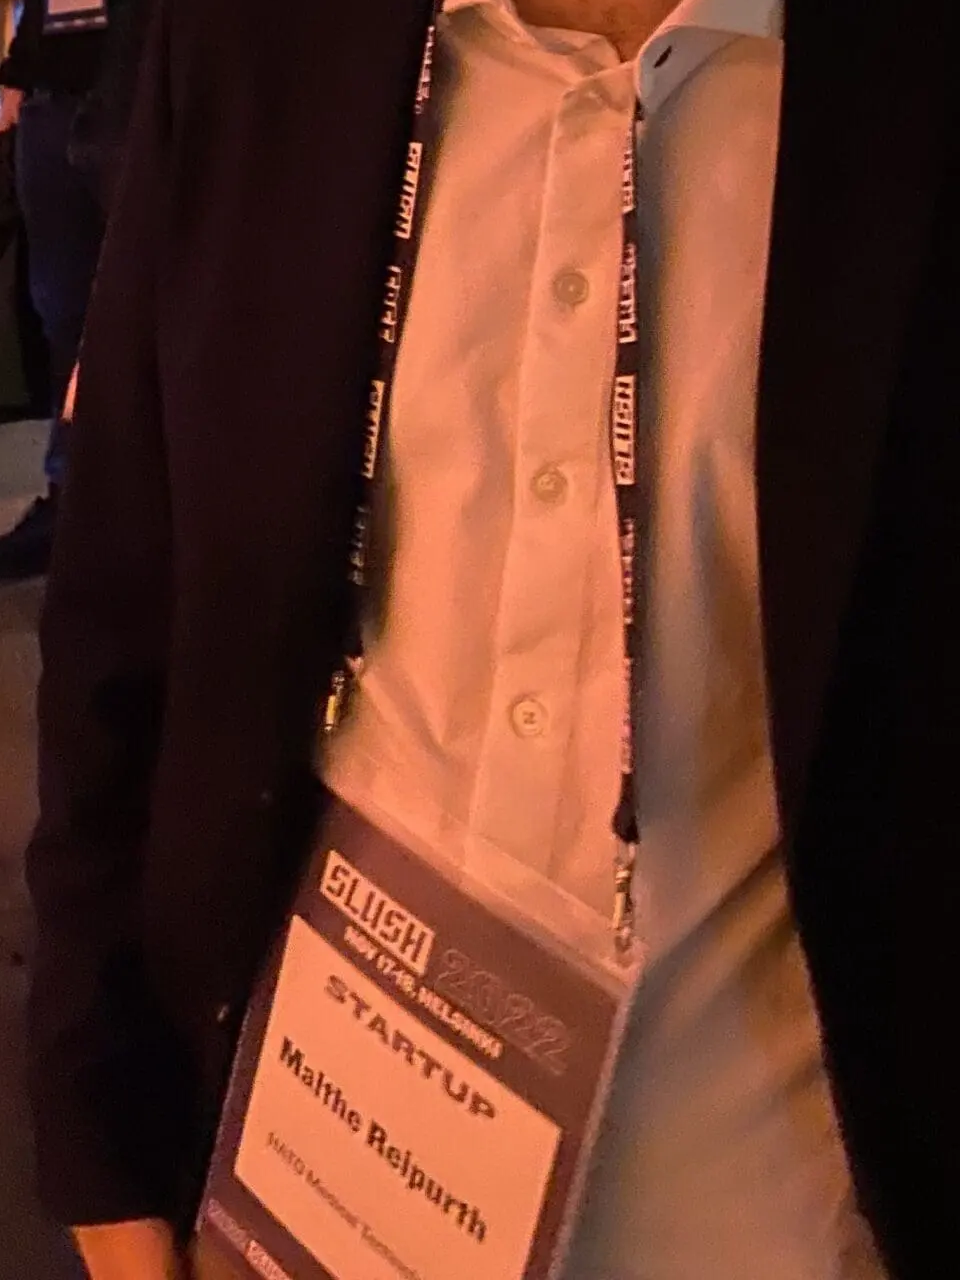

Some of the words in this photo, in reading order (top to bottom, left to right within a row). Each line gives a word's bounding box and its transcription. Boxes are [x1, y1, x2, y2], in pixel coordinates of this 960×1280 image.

[324, 861, 430, 968] SLUSH
[323, 973, 497, 1120] STARTUP
[278, 1035, 363, 1134] Malthe
[366, 1119, 488, 1244] Reipurth
